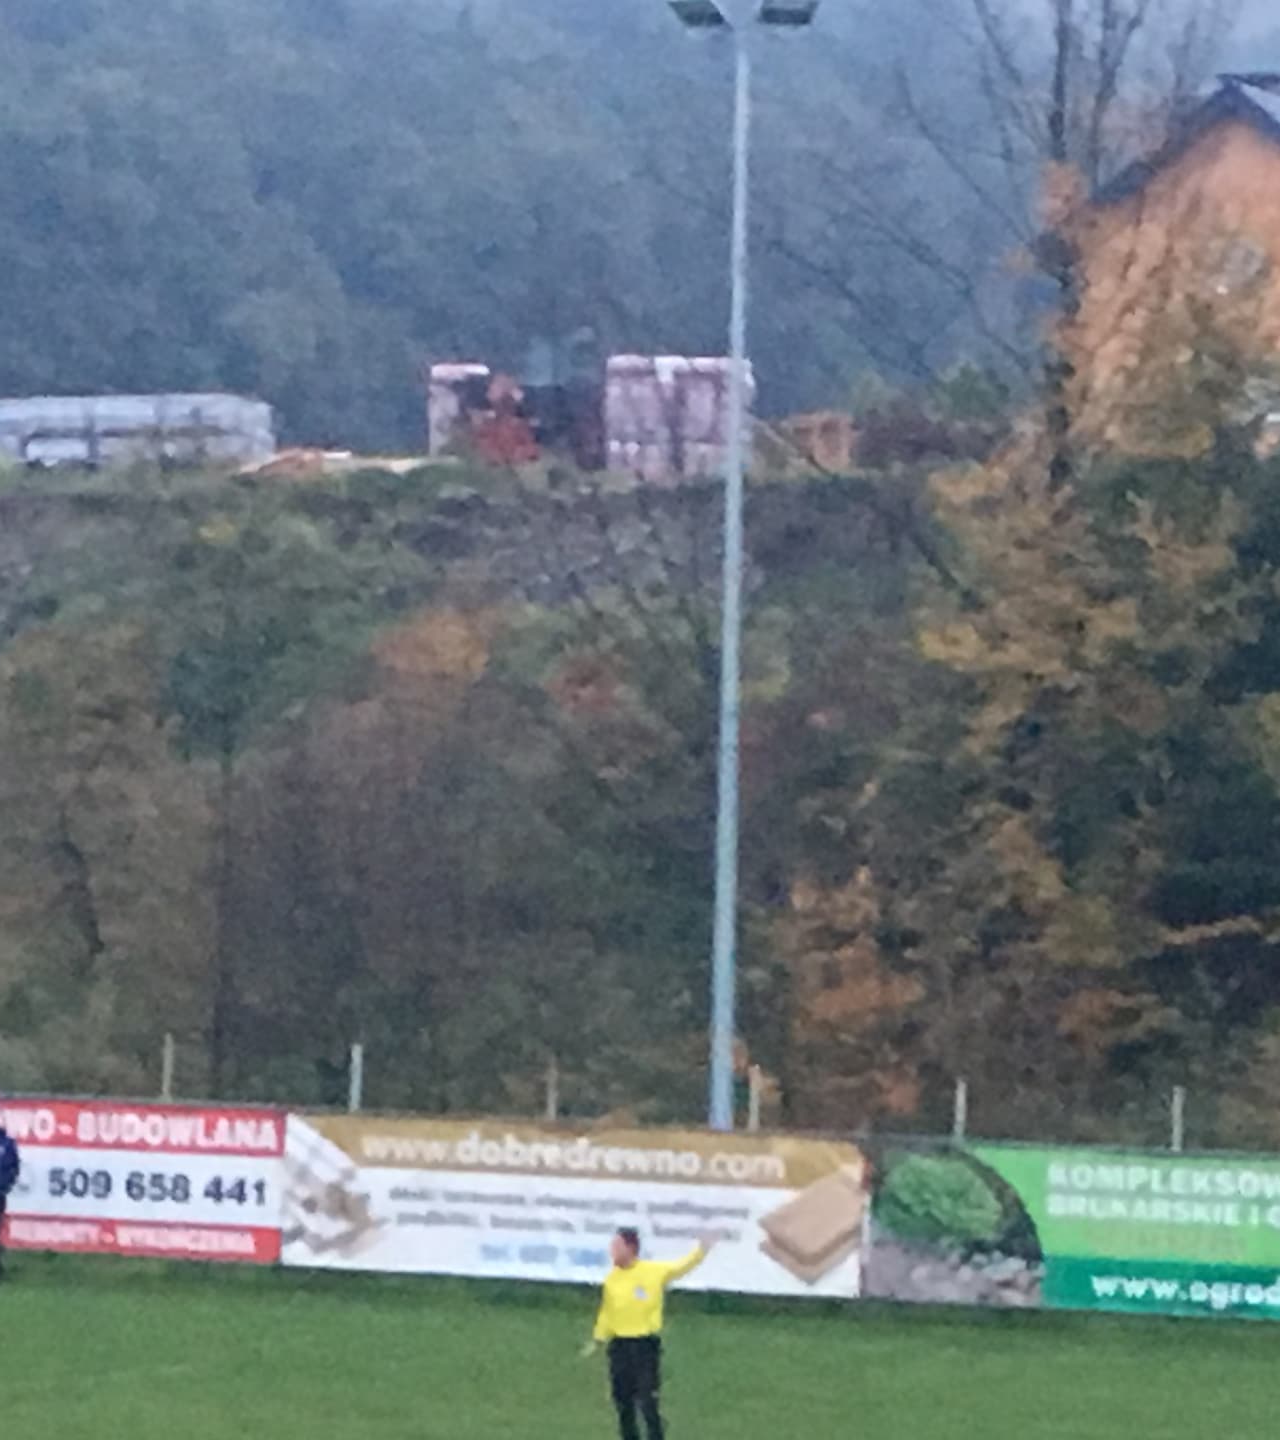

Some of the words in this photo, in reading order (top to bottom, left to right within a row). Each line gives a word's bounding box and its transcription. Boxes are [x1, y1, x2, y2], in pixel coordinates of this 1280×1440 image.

[48, 1166, 113, 1199] 509
[125, 1170, 191, 1205] 658
[203, 1175, 266, 1206] 441
